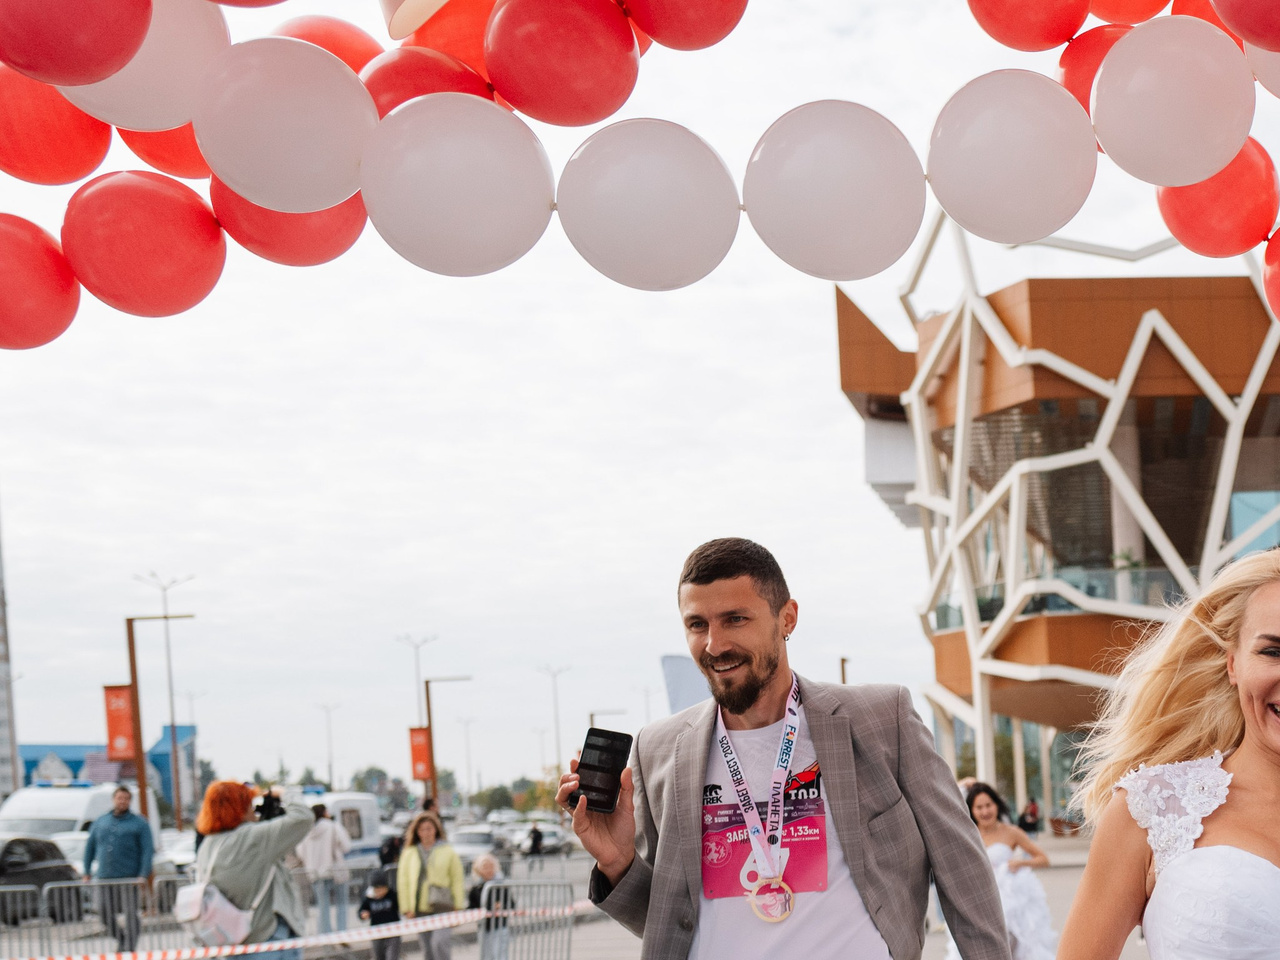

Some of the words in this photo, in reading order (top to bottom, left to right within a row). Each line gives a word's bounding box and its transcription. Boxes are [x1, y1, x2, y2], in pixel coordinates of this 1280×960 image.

[718, 735, 733, 758] 2025
[779, 725, 796, 771] FORREST
[726, 757, 745, 788] НЕВЕСТ
[736, 787, 755, 814] ЗАБЕГ
[769, 781, 782, 832] ПЛАНЕТА
[726, 829, 749, 843] ЗАБЕ
